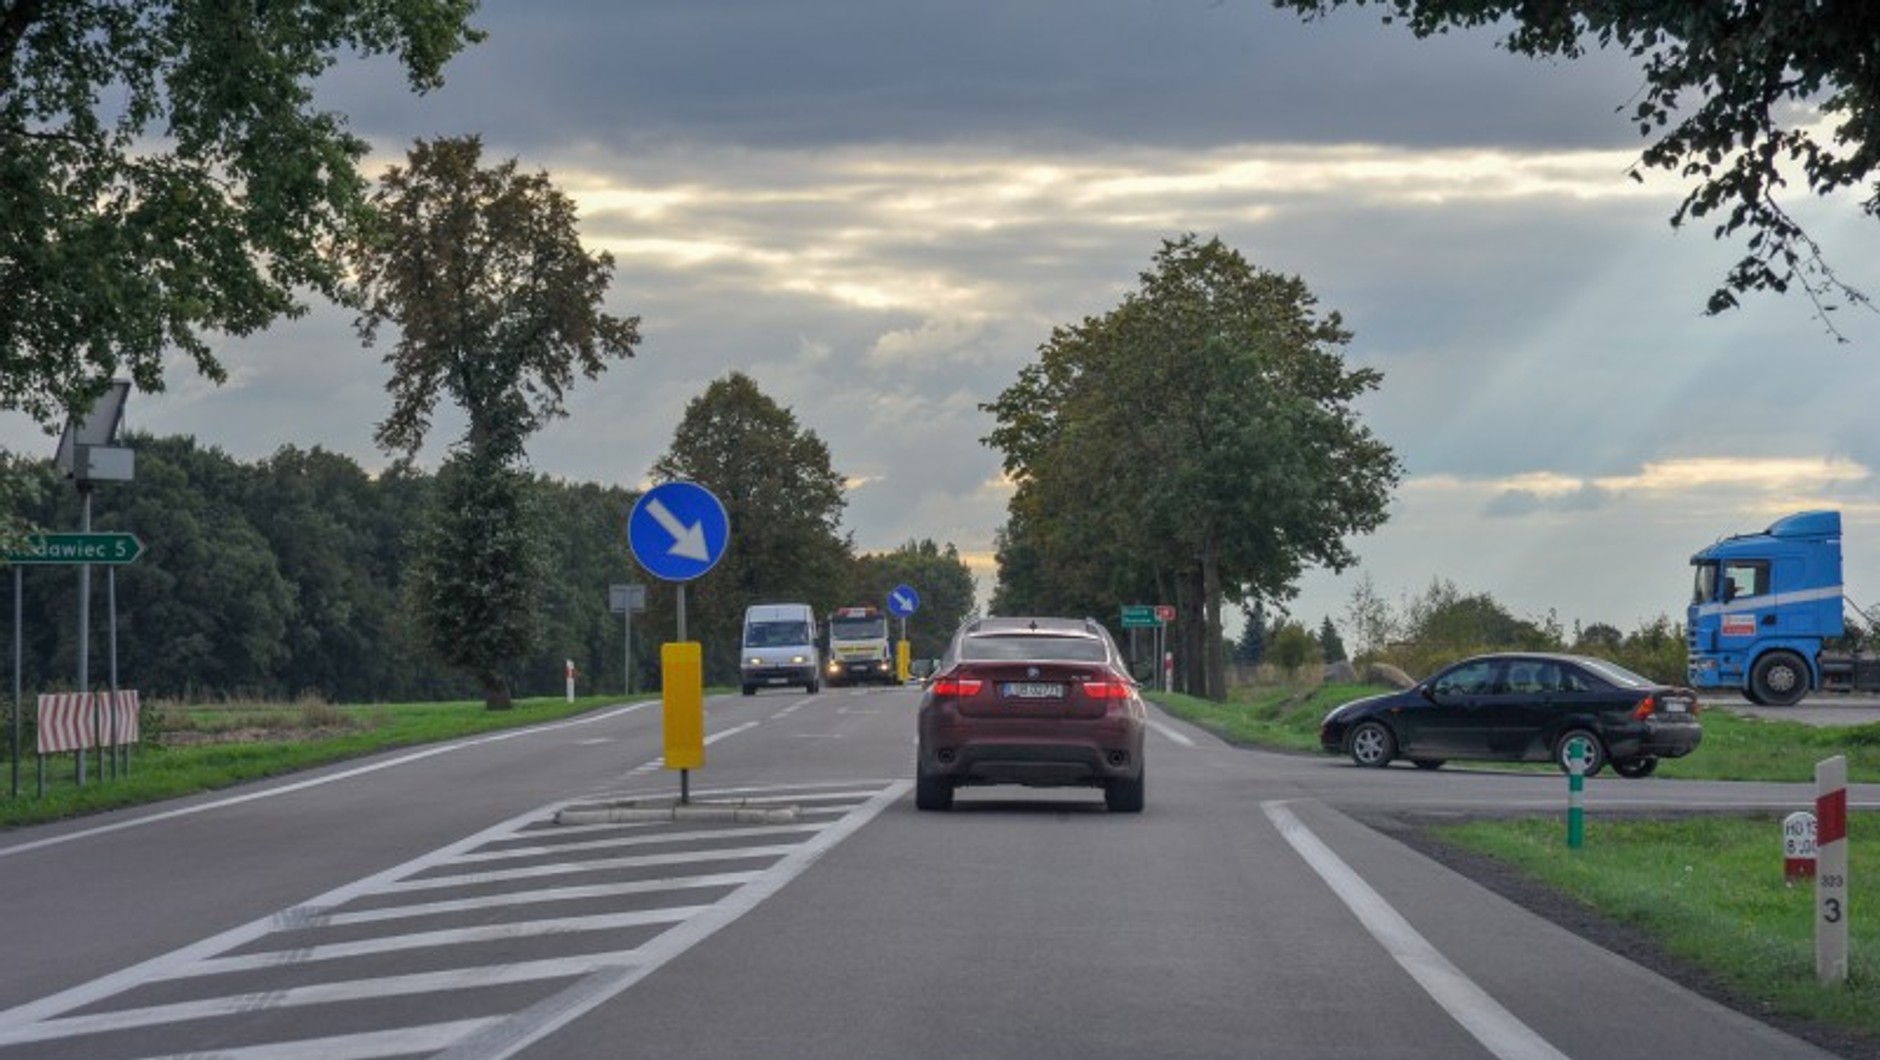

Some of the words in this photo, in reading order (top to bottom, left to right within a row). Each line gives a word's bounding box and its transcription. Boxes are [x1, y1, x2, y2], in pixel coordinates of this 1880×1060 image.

[7, 540, 105, 558] dawiec
[115, 541, 126, 557] 5
[1824, 898, 1841, 923] 3
